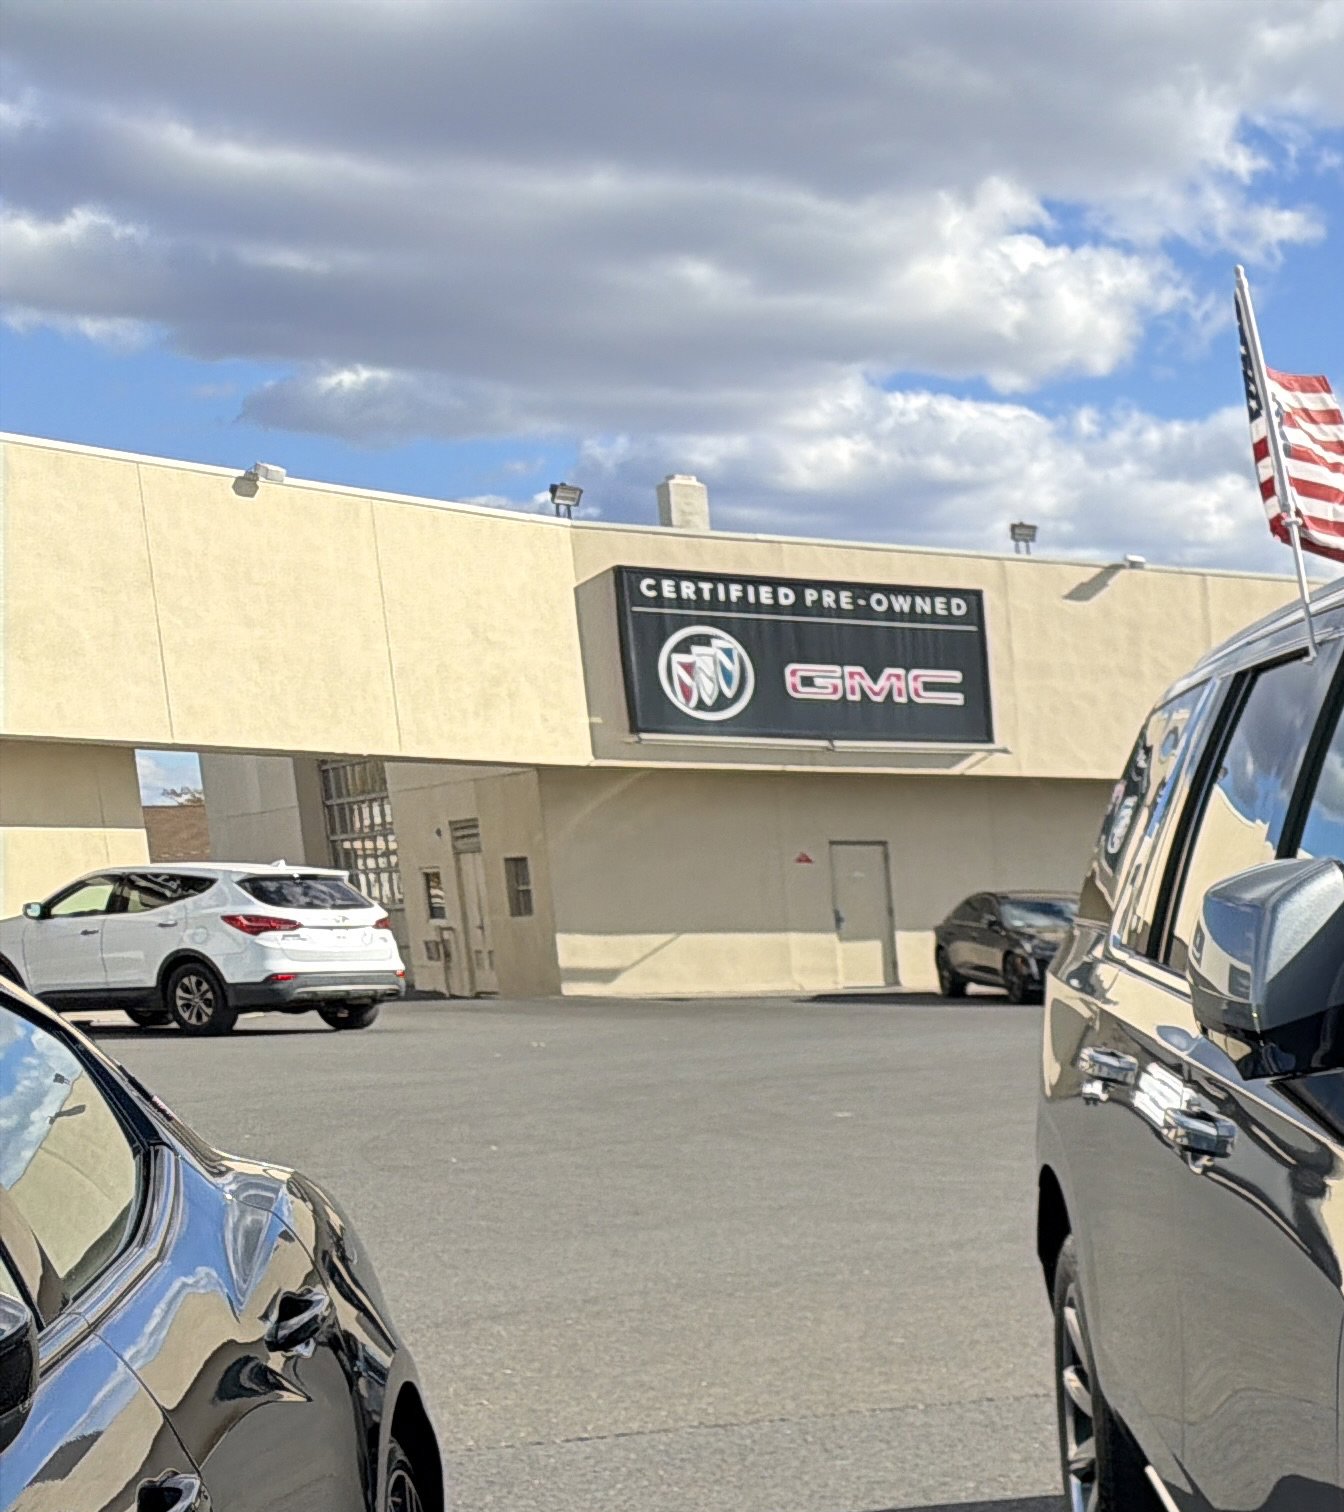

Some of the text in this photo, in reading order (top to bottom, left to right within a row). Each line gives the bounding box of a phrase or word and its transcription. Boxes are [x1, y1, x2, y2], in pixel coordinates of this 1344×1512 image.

[640, 578, 968, 616] CERTIFIED PRE-OWNED
[784, 663, 965, 706] GMC
